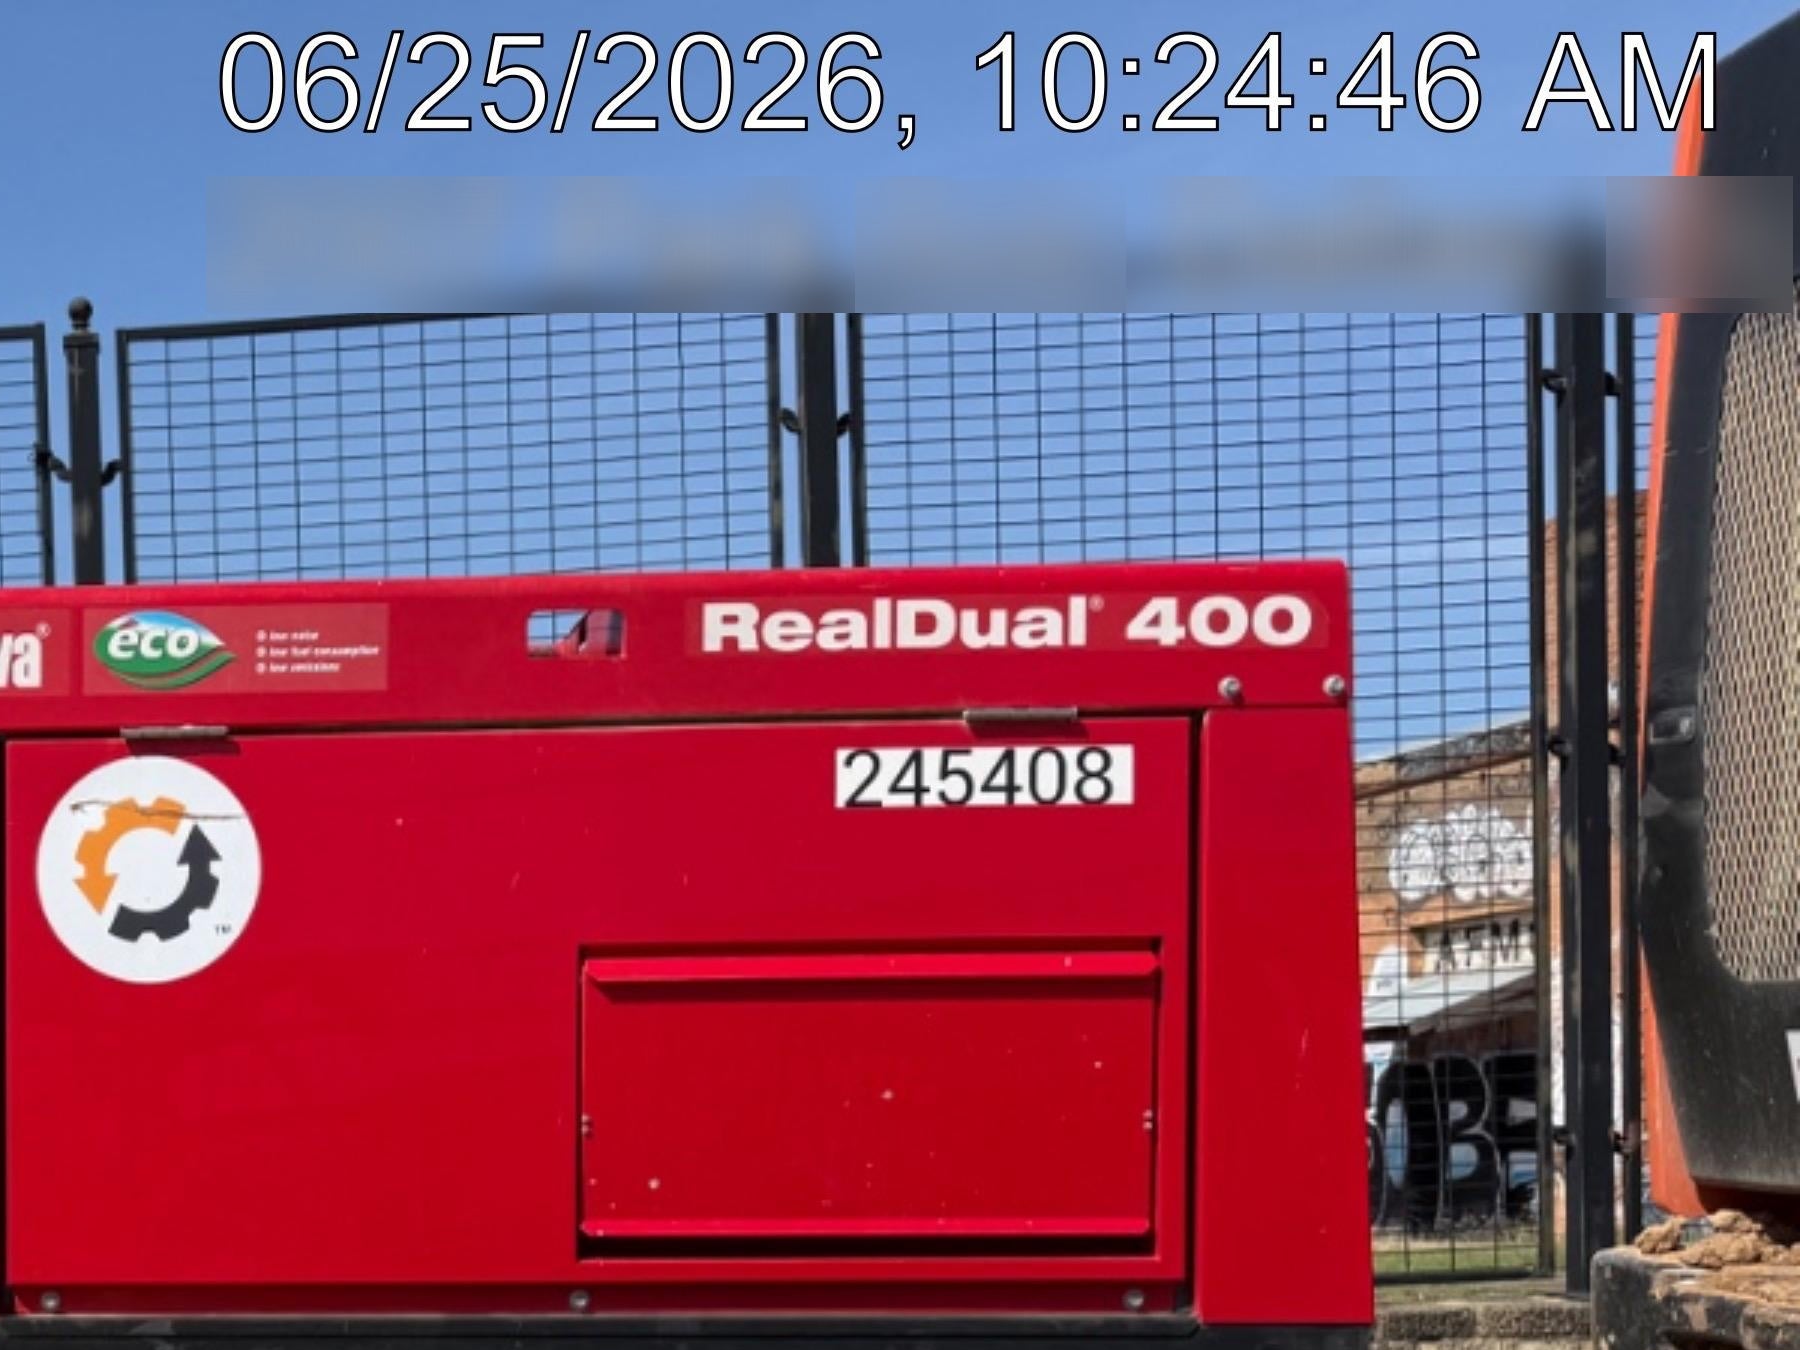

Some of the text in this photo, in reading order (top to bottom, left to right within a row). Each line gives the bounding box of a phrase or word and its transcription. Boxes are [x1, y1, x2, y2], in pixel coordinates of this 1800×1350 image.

[107, 627, 200, 659] eco
[1126, 595, 1312, 646] 400
[842, 747, 1114, 806] 245408
